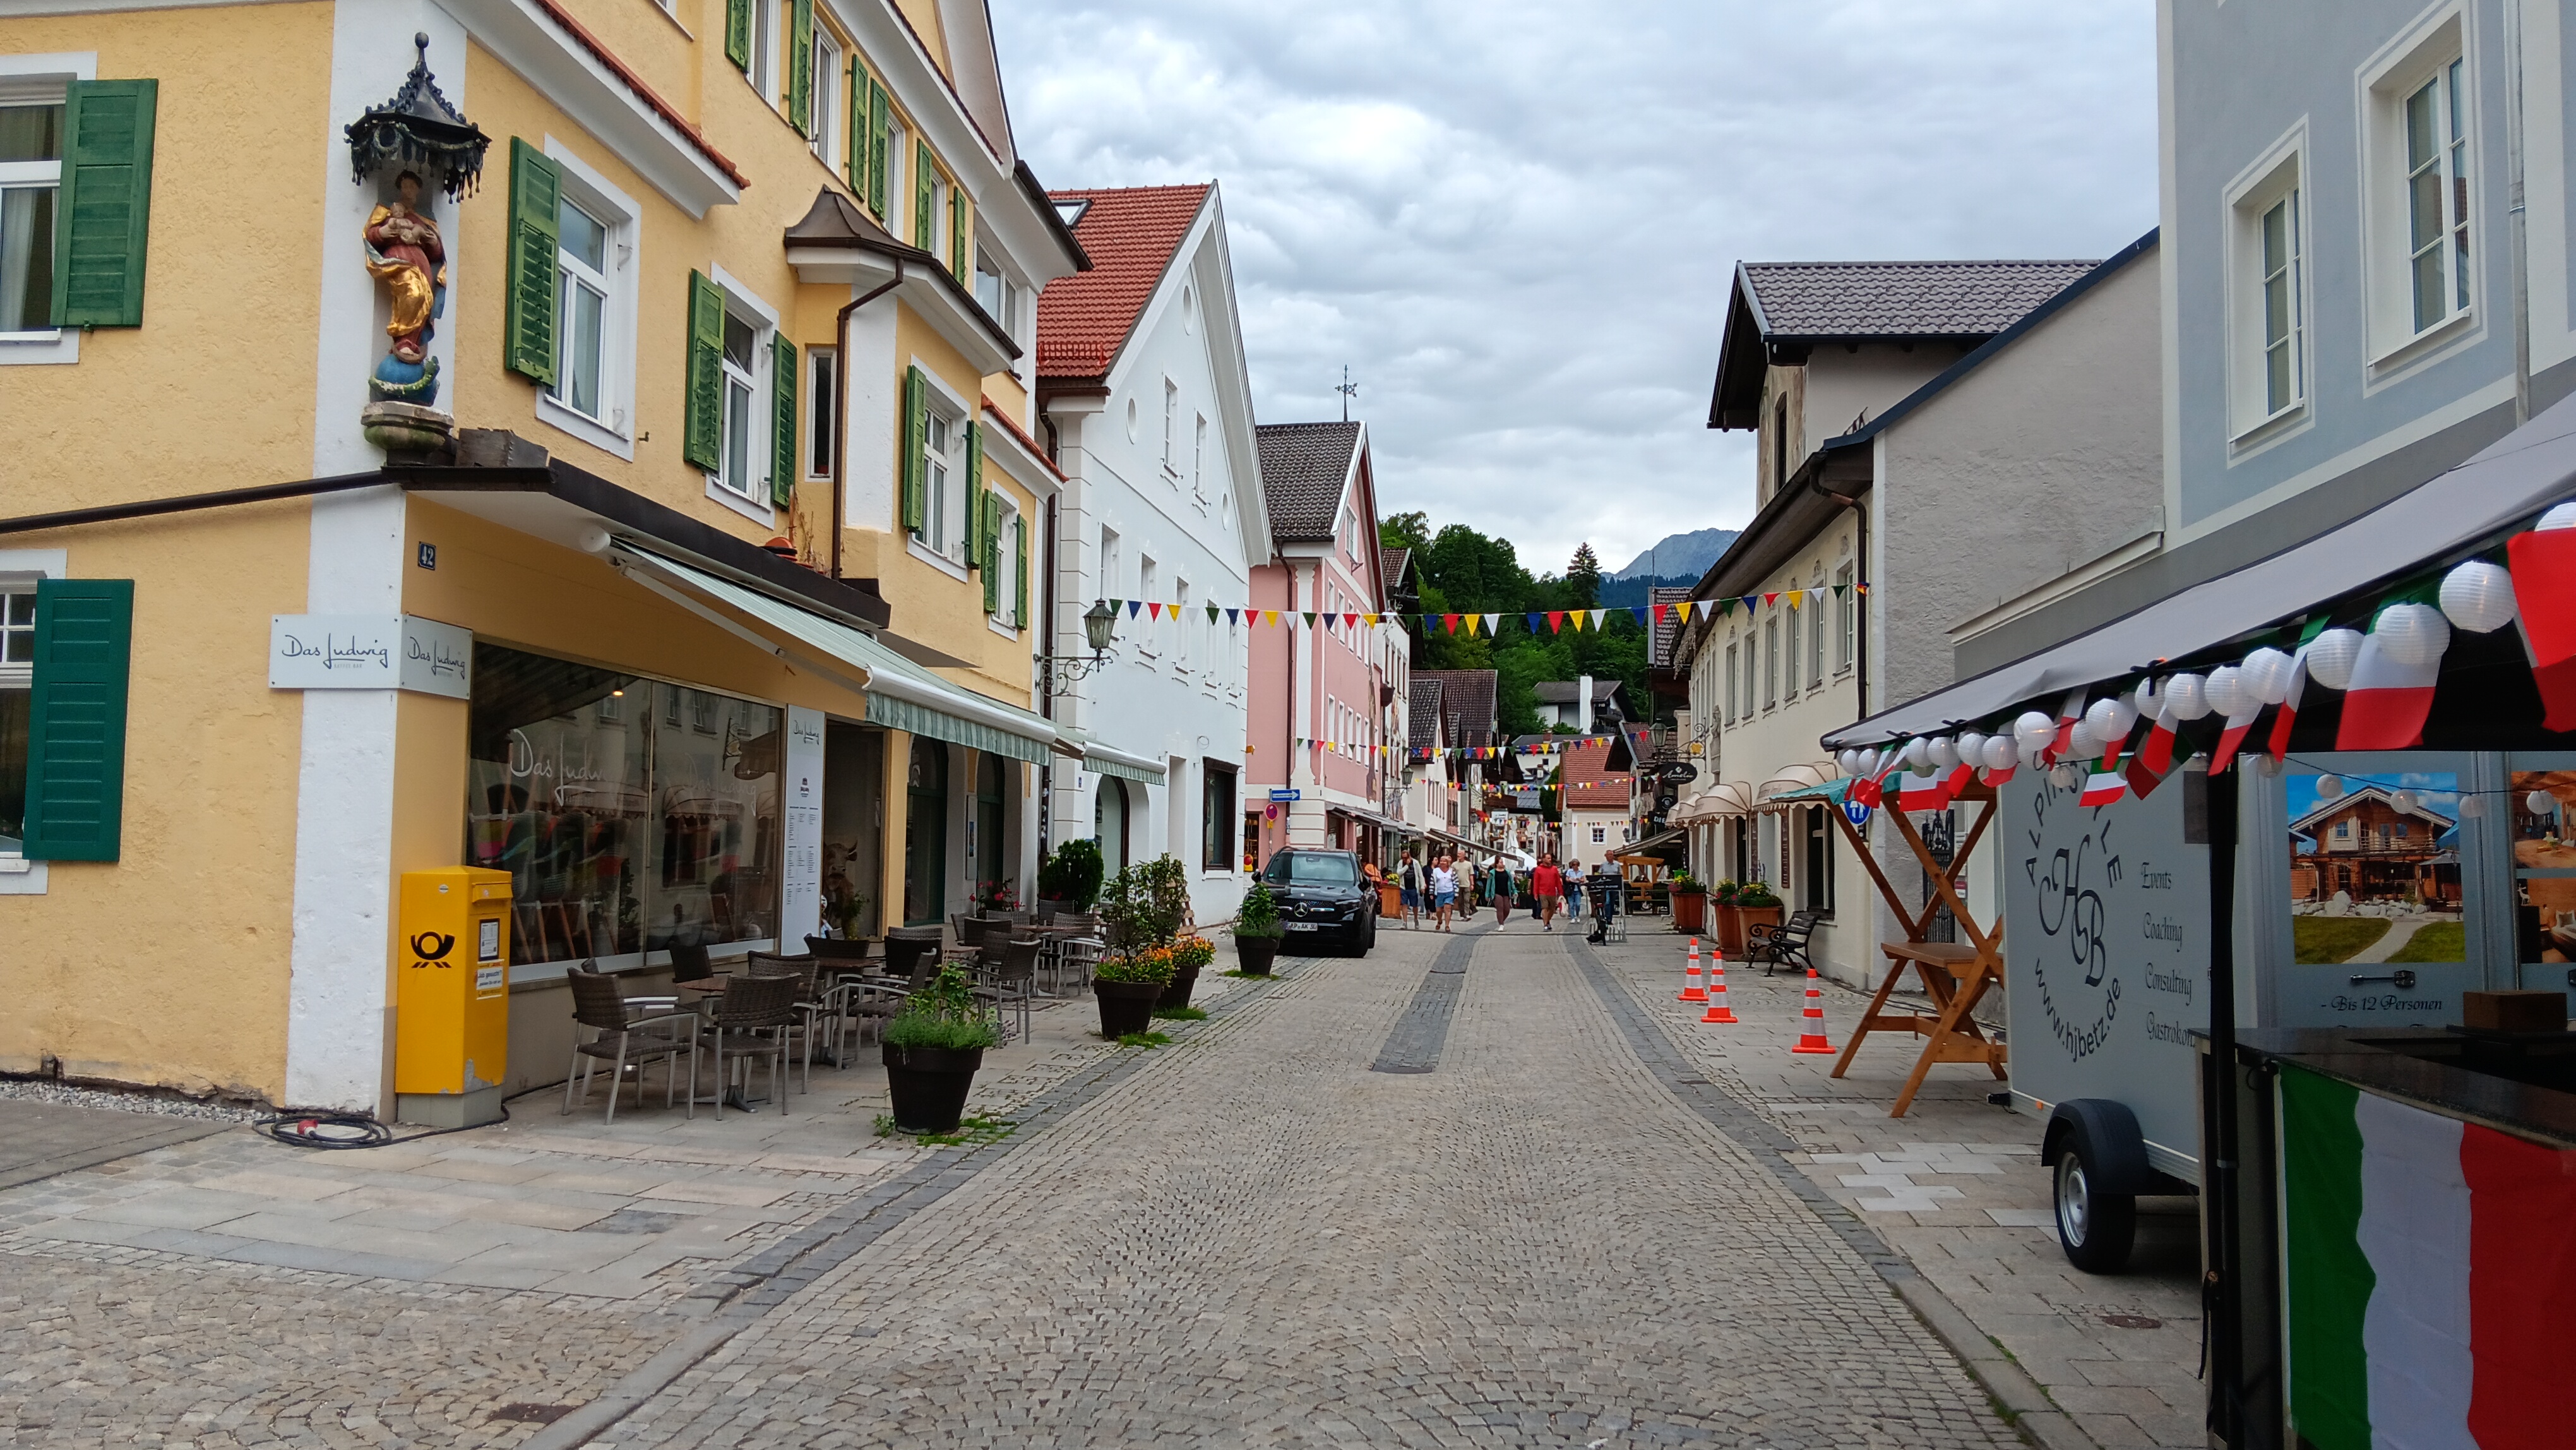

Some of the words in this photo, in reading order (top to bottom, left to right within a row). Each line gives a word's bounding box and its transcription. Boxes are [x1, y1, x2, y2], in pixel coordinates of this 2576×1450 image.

[421, 546, 434, 566] 42
[282, 634, 321, 657] Das
[323, 632, 388, 669] Ludwig
[407, 636, 431, 661] Das
[431, 639, 465, 680] Ludwig
[794, 719, 803, 735] Das
[510, 728, 552, 777] Das
[554, 731, 604, 807] Ludw
[2142, 862, 2172, 889] Events
[2144, 912, 2183, 952] Coaching
[2145, 962, 2192, 1006] Consulting
[2331, 995, 2358, 1011] Bis
[2362, 996, 2377, 1010] 12
[2380, 995, 2443, 1010] Personen
[2036, 958, 2120, 1063] www.hjbetz.de
